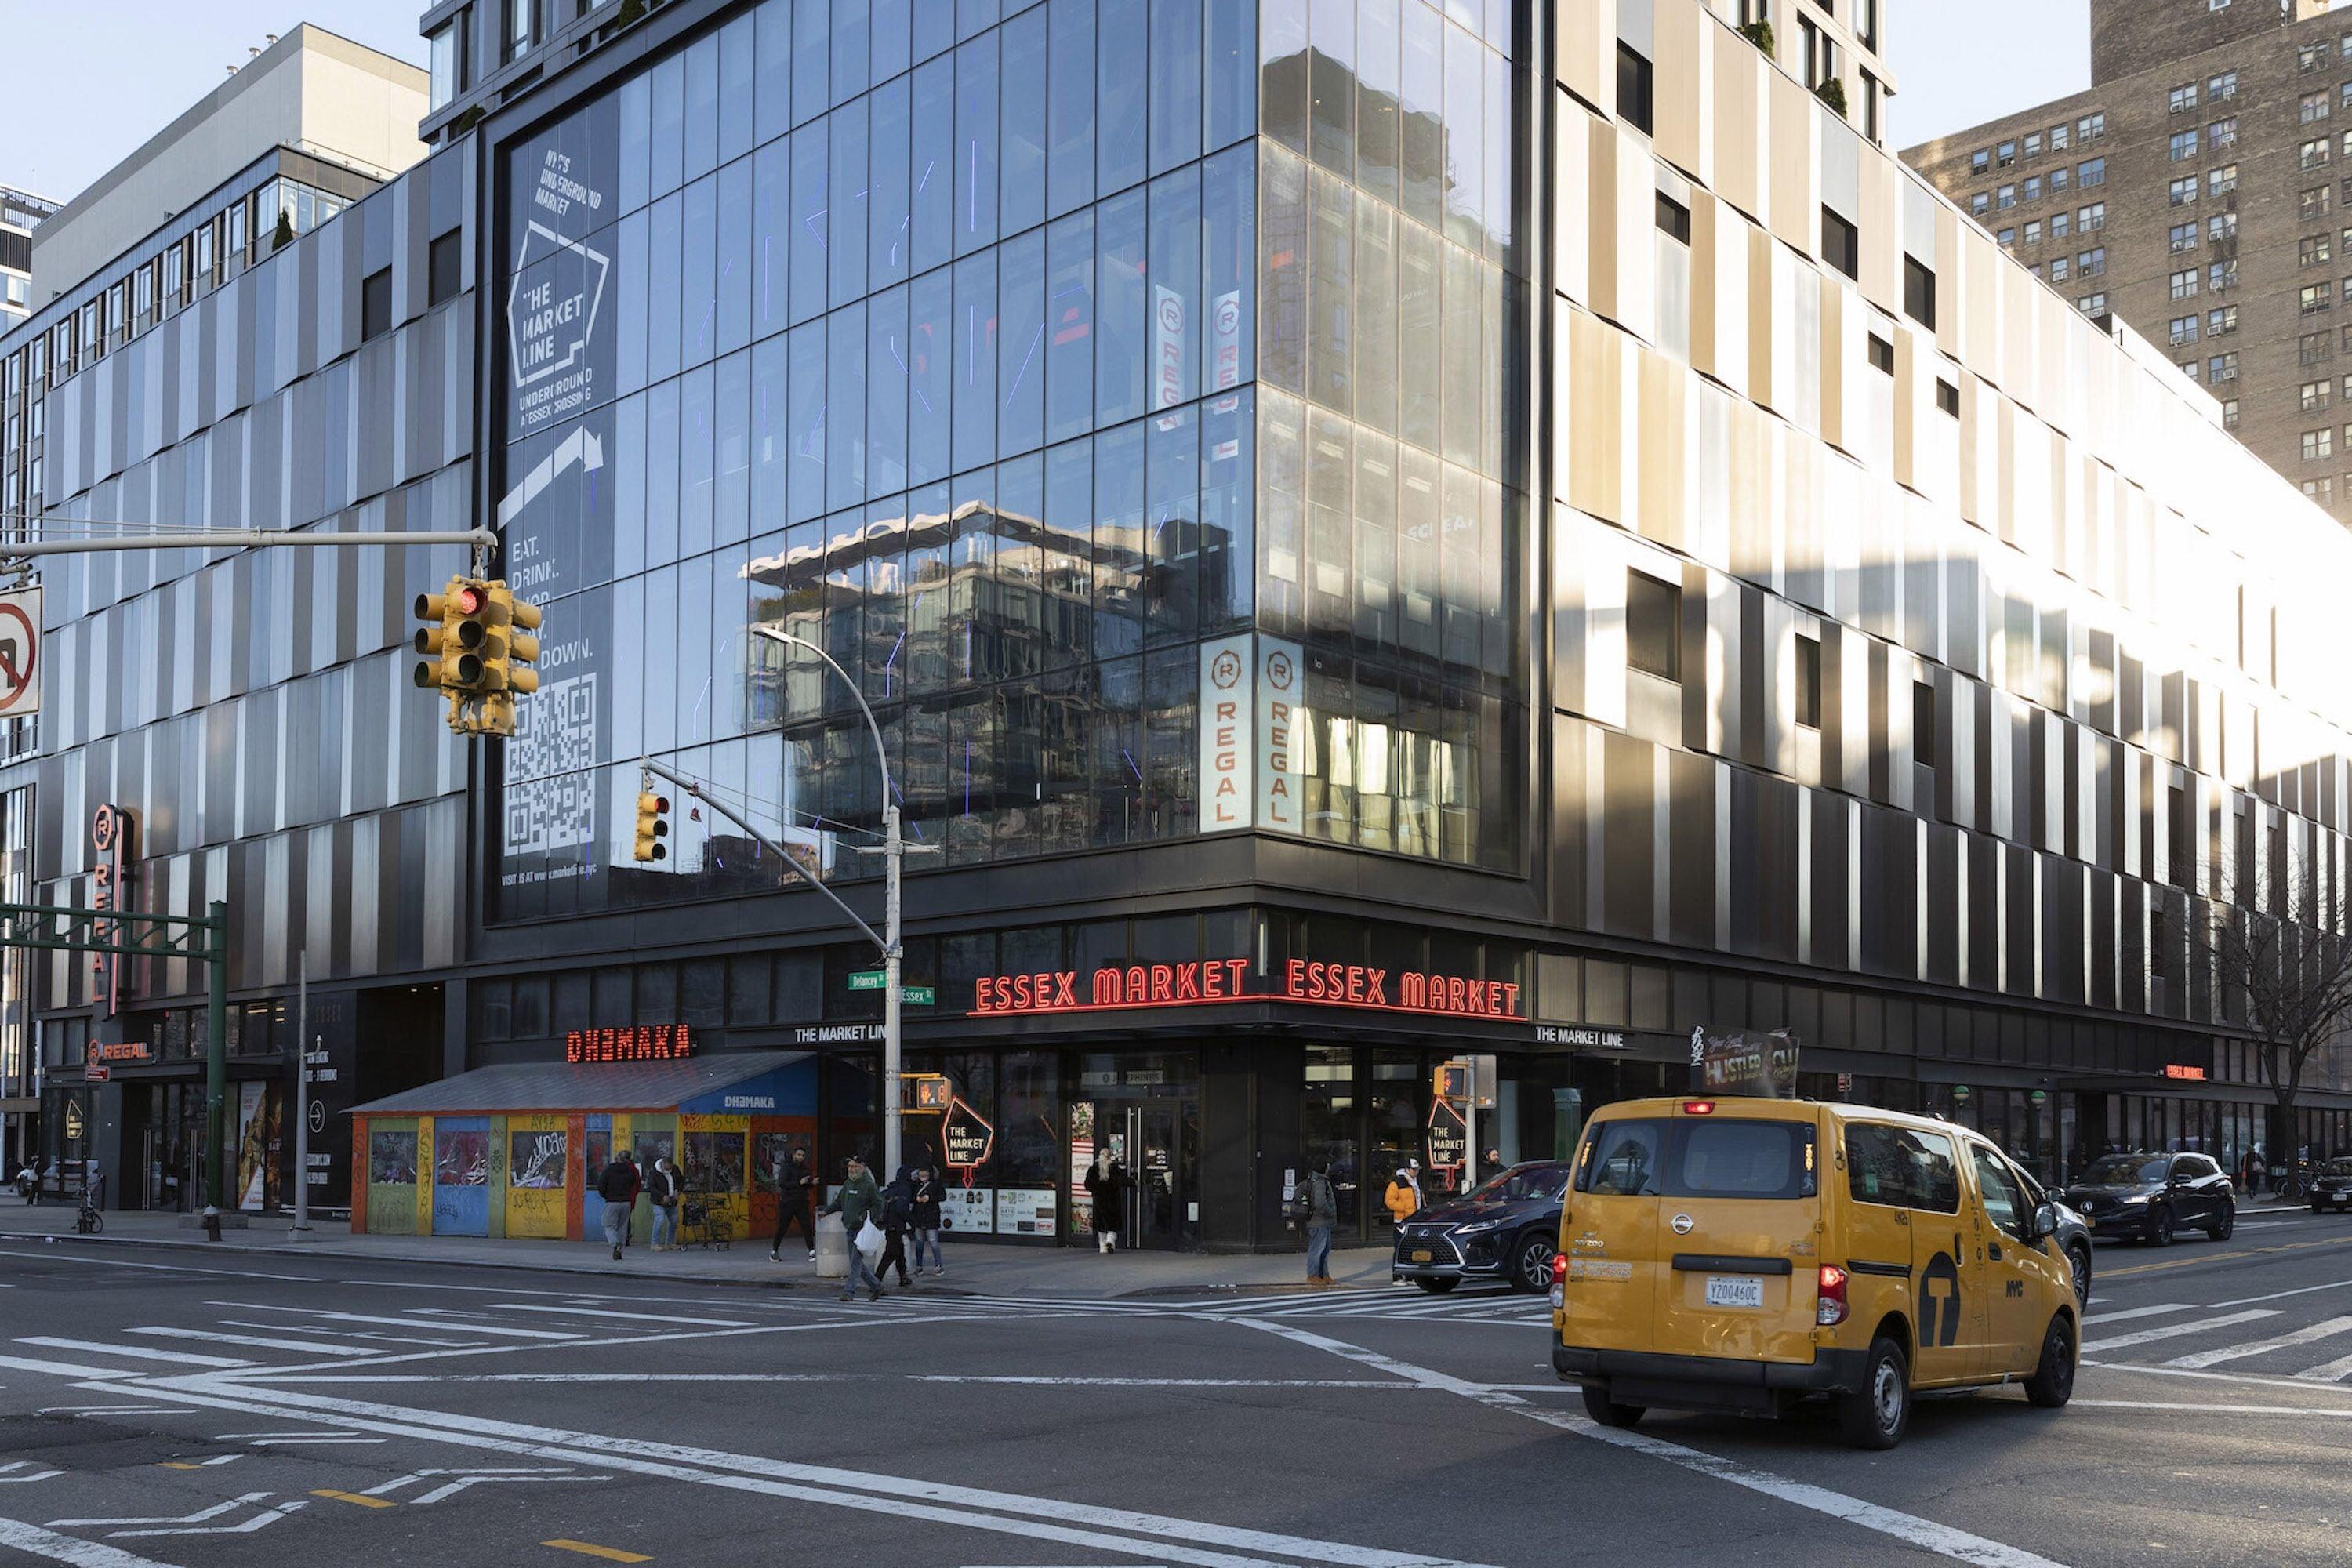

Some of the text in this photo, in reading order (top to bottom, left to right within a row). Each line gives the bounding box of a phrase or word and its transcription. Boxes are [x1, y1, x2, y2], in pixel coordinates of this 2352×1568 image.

[539, 168, 602, 210] UNDERGROUND
[535, 187, 571, 216] MARKET
[523, 293, 583, 342] MARKET
[522, 335, 554, 369] LINE
[519, 368, 593, 412] UNDERGROUND
[528, 402, 552, 425] ESSEX
[512, 536, 539, 563] EAT.
[512, 558, 560, 590] DRINK.
[541, 638, 593, 670] DOWN.
[1219, 664, 1233, 678] R
[1274, 663, 1286, 678] R
[1215, 702, 1237, 822] REGAL
[1270, 702, 1290, 823] REGAL
[98, 819, 108, 836] R
[853, 975, 878, 988] Delancey
[975, 958, 1249, 1011] ESSEX MARKET
[1287, 958, 1521, 1015] ESSEX MARKET
[902, 989, 924, 1002] Essex
[794, 1024, 887, 1042] THE MARKET LIN
[1535, 1026, 1624, 1047] THE MARKET LINE
[103, 1042, 149, 1060] REGAL
[950, 1126, 967, 1137] THE
[1432, 1126, 1449, 1138] THE
[949, 1138, 985, 1149] MARKET
[1433, 1139, 1465, 1150] MARKET
[949, 1150, 969, 1162] LINE
[1433, 1151, 1451, 1163] LINE
[2005, 1279, 2024, 1298] NYC
